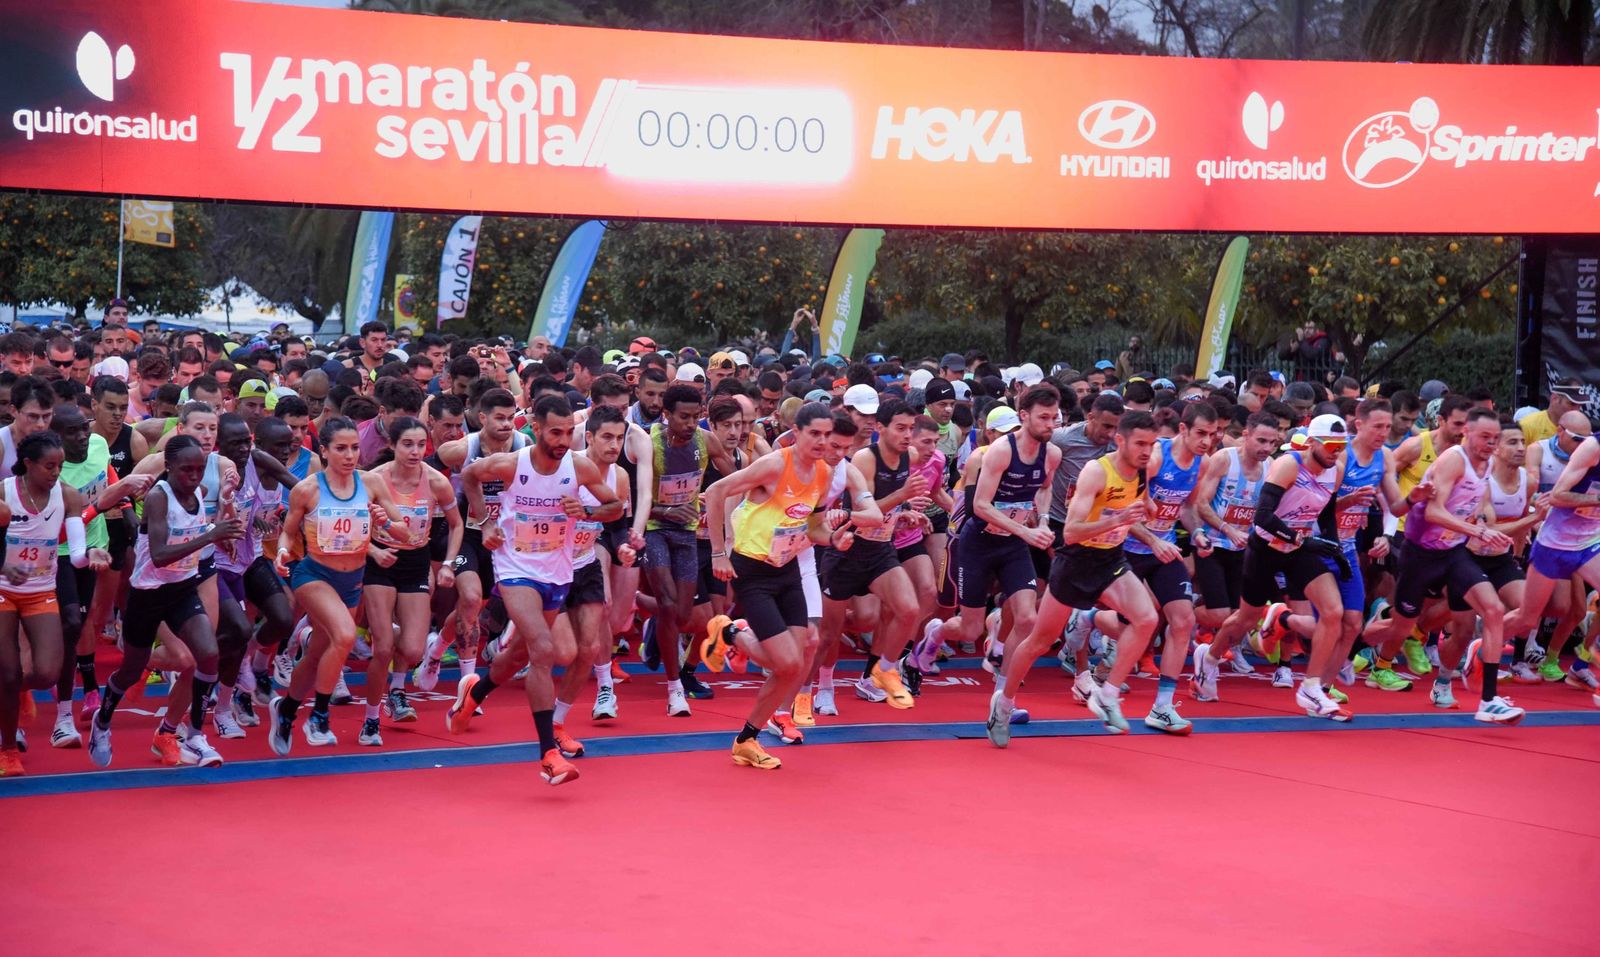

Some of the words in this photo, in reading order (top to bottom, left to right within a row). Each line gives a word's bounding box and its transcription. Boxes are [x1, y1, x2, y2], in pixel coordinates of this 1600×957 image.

[301, 58, 577, 116] maratón
[12, 106, 198, 142] quirónsalud
[637, 108, 826, 154] 00:00:00
[375, 110, 577, 167] sevilla
[1430, 123, 1596, 168] Sprinter
[1060, 154, 1171, 179] HYUNDAI
[1196, 156, 1327, 184] quirónsalud
[458, 226, 477, 242] 1
[450, 247, 474, 314] CAJÓN
[1576, 258, 1598, 339] FINISH
[676, 479, 688, 491] 11
[515, 495, 563, 508] ESERCIT
[1009, 509, 1018, 519] 6
[333, 518, 352, 534] 40
[532, 523, 549, 535] 19
[574, 532, 591, 545] 99
[18, 547, 39, 561] 43
